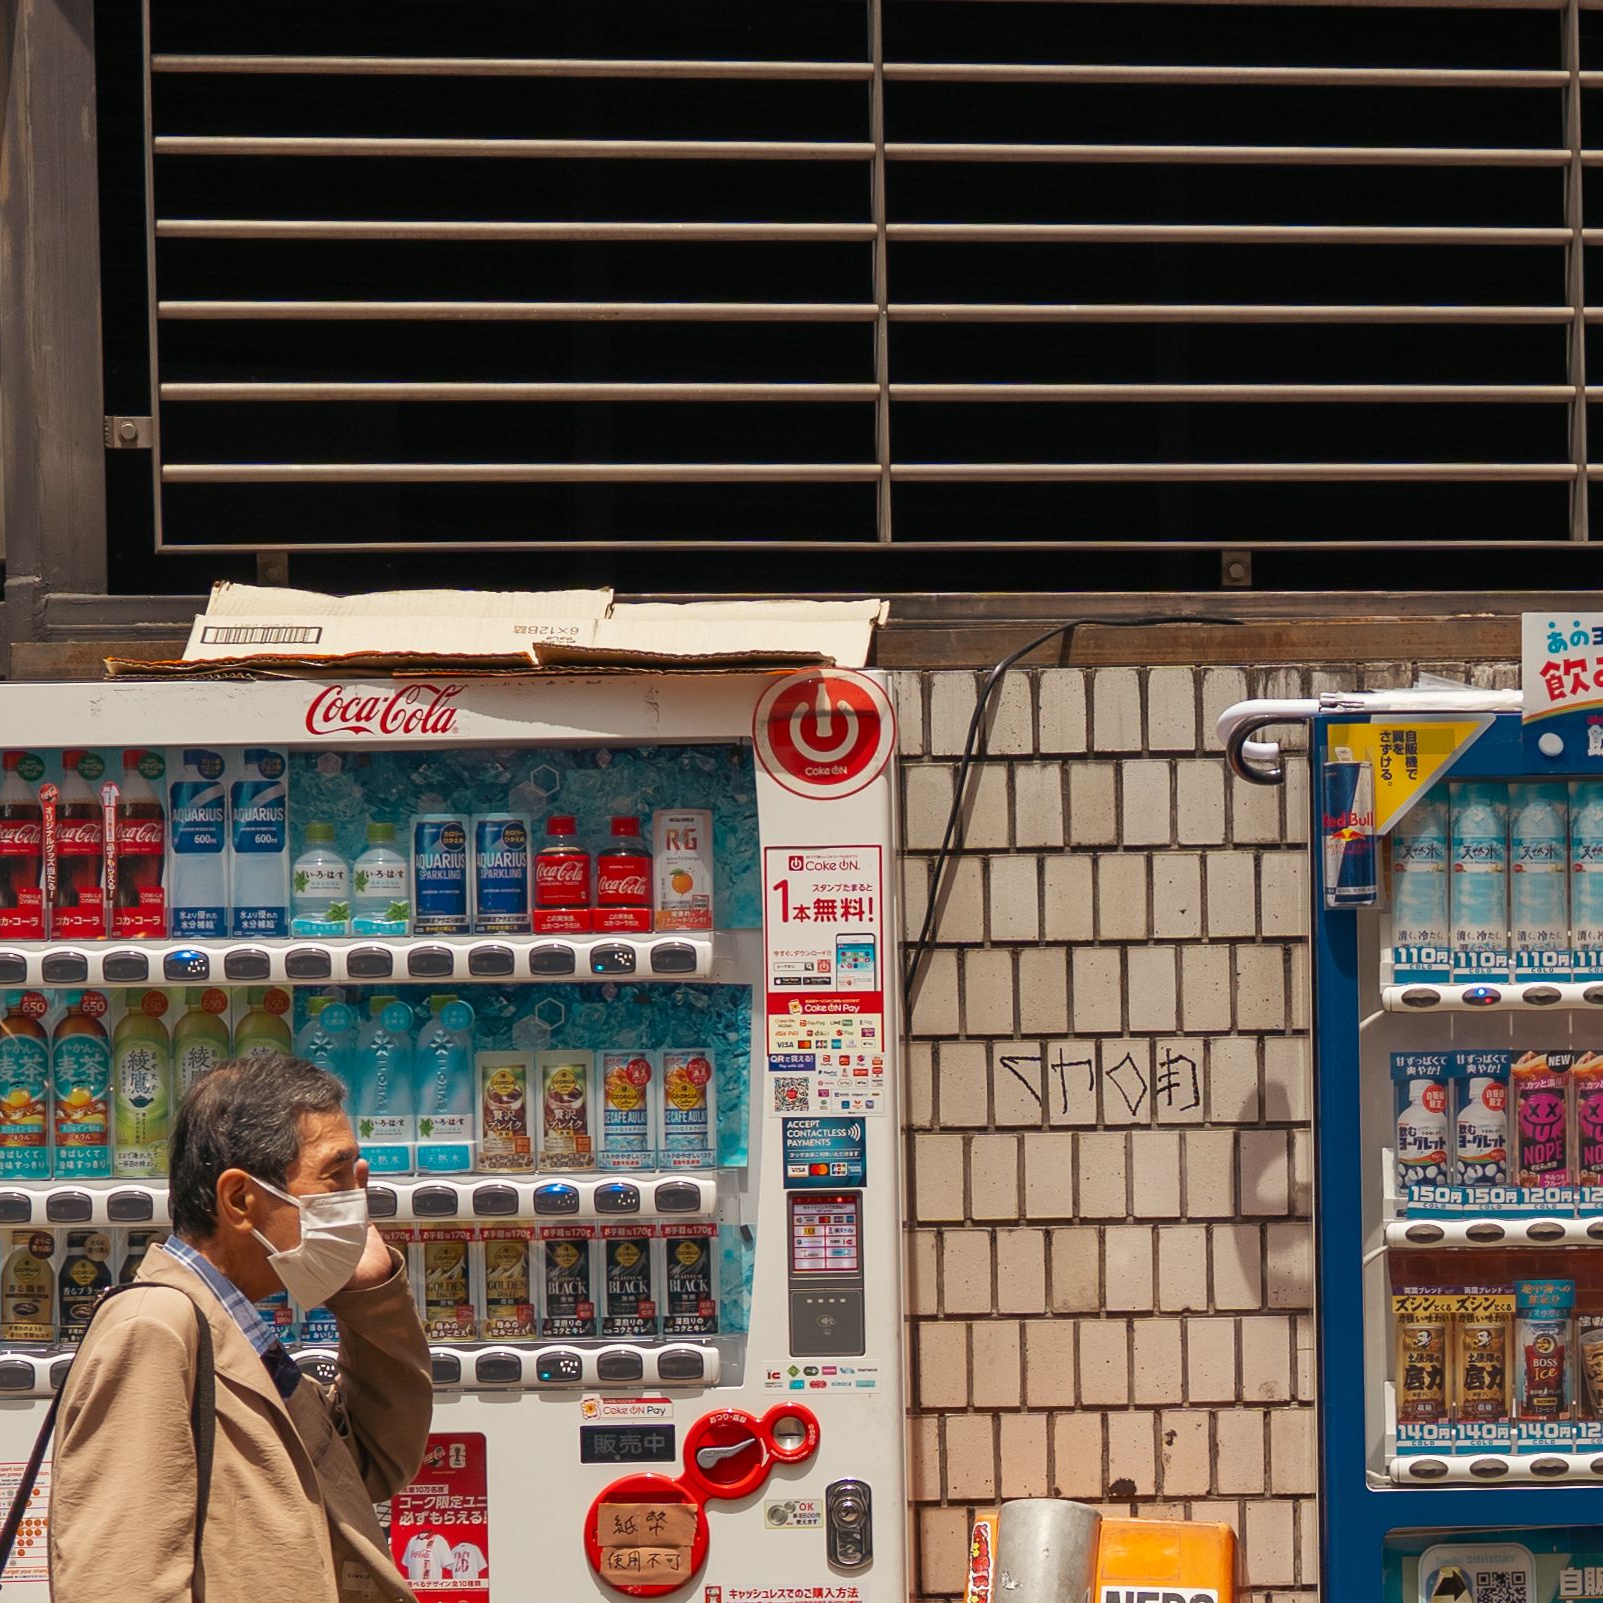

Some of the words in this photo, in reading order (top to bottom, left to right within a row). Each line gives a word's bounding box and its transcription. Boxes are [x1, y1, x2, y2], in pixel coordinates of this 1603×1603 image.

[1379, 730, 1394, 787] さずける。
[1405, 730, 1418, 781] 自販機で
[805, 766, 830, 775] Coke
[172, 807, 224, 823] AQUARIUS
[805, 860, 837, 871] Coke
[418, 868, 462, 881] SPARKLING
[812, 884, 873, 892] スタンプたまると
[773, 879, 874, 923] 1本無料!
[115, 915, 161, 926] コカ・コーラ
[22, 1001, 46, 1013] 650
[81, 1001, 105, 1013] 650
[804, 1003, 827, 1013] Coke
[842, 1003, 860, 1014] Pay
[777, 1041, 794, 1049] VISA
[1396, 1056, 1448, 1067] 甘ずっぱくて
[55, 1056, 107, 1082] 麦茶
[127, 1050, 151, 1094] 綾鷹
[1406, 1065, 1441, 1076] 爽やか!
[492, 1109, 518, 1121] 贅沢
[487, 1119, 524, 1130] ブレイク
[787, 1120, 820, 1129] ACCEPT
[787, 1128, 847, 1138] CONTACTLESS
[787, 1138, 831, 1147] PAYMENTS
[1523, 1139, 1563, 1162] NOPE
[1464, 1187, 1517, 1202] 150円
[548, 1281, 587, 1295] BLACK
[608, 1281, 648, 1294] BLACK
[1396, 1296, 1452, 1312] ズシンとくる
[551, 1327, 586, 1336] コクとキレ
[1533, 1358, 1558, 1367] BOSS
[1534, 1367, 1557, 1380] Ice
[602, 1405, 628, 1416] Coke
[647, 1405, 666, 1417] Pay
[1456, 1424, 1510, 1439] 140円
[593, 1433, 665, 1454] 販売中
[399, 1495, 487, 1509] コーク限定ユニ
[798, 1502, 815, 1512] OK
[399, 1511, 487, 1526] 必ずもらえる!
[607, 1552, 681, 1573] 使用不可
[729, 1587, 860, 1600] キャッシュレスでのご購入方法
